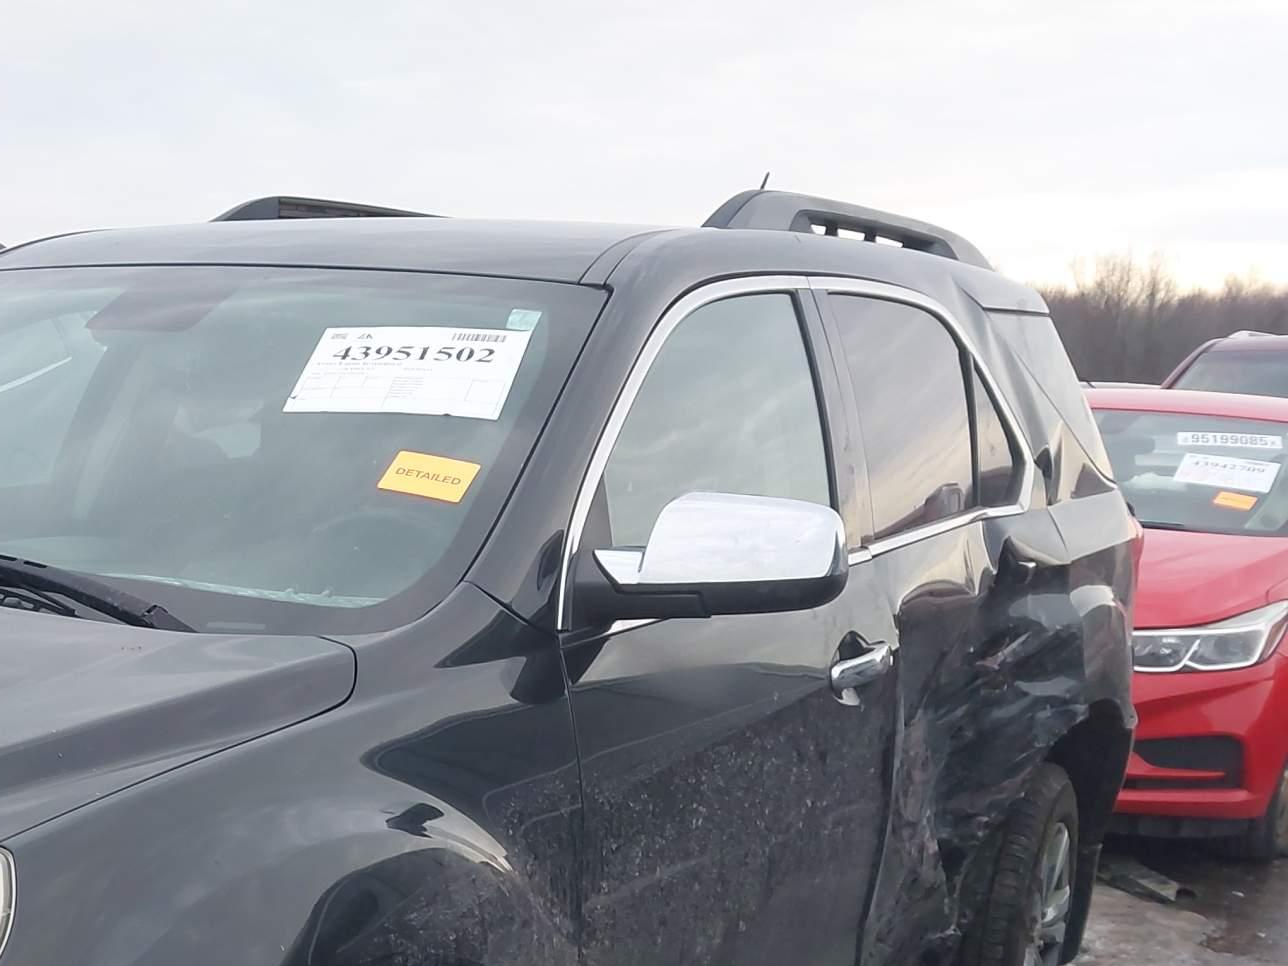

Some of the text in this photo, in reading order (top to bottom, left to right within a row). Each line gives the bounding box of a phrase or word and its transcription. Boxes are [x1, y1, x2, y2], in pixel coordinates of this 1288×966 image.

[332, 345, 496, 363] 43951502
[1191, 433, 1269, 446] 95199085
[395, 466, 462, 487] DETAILED
